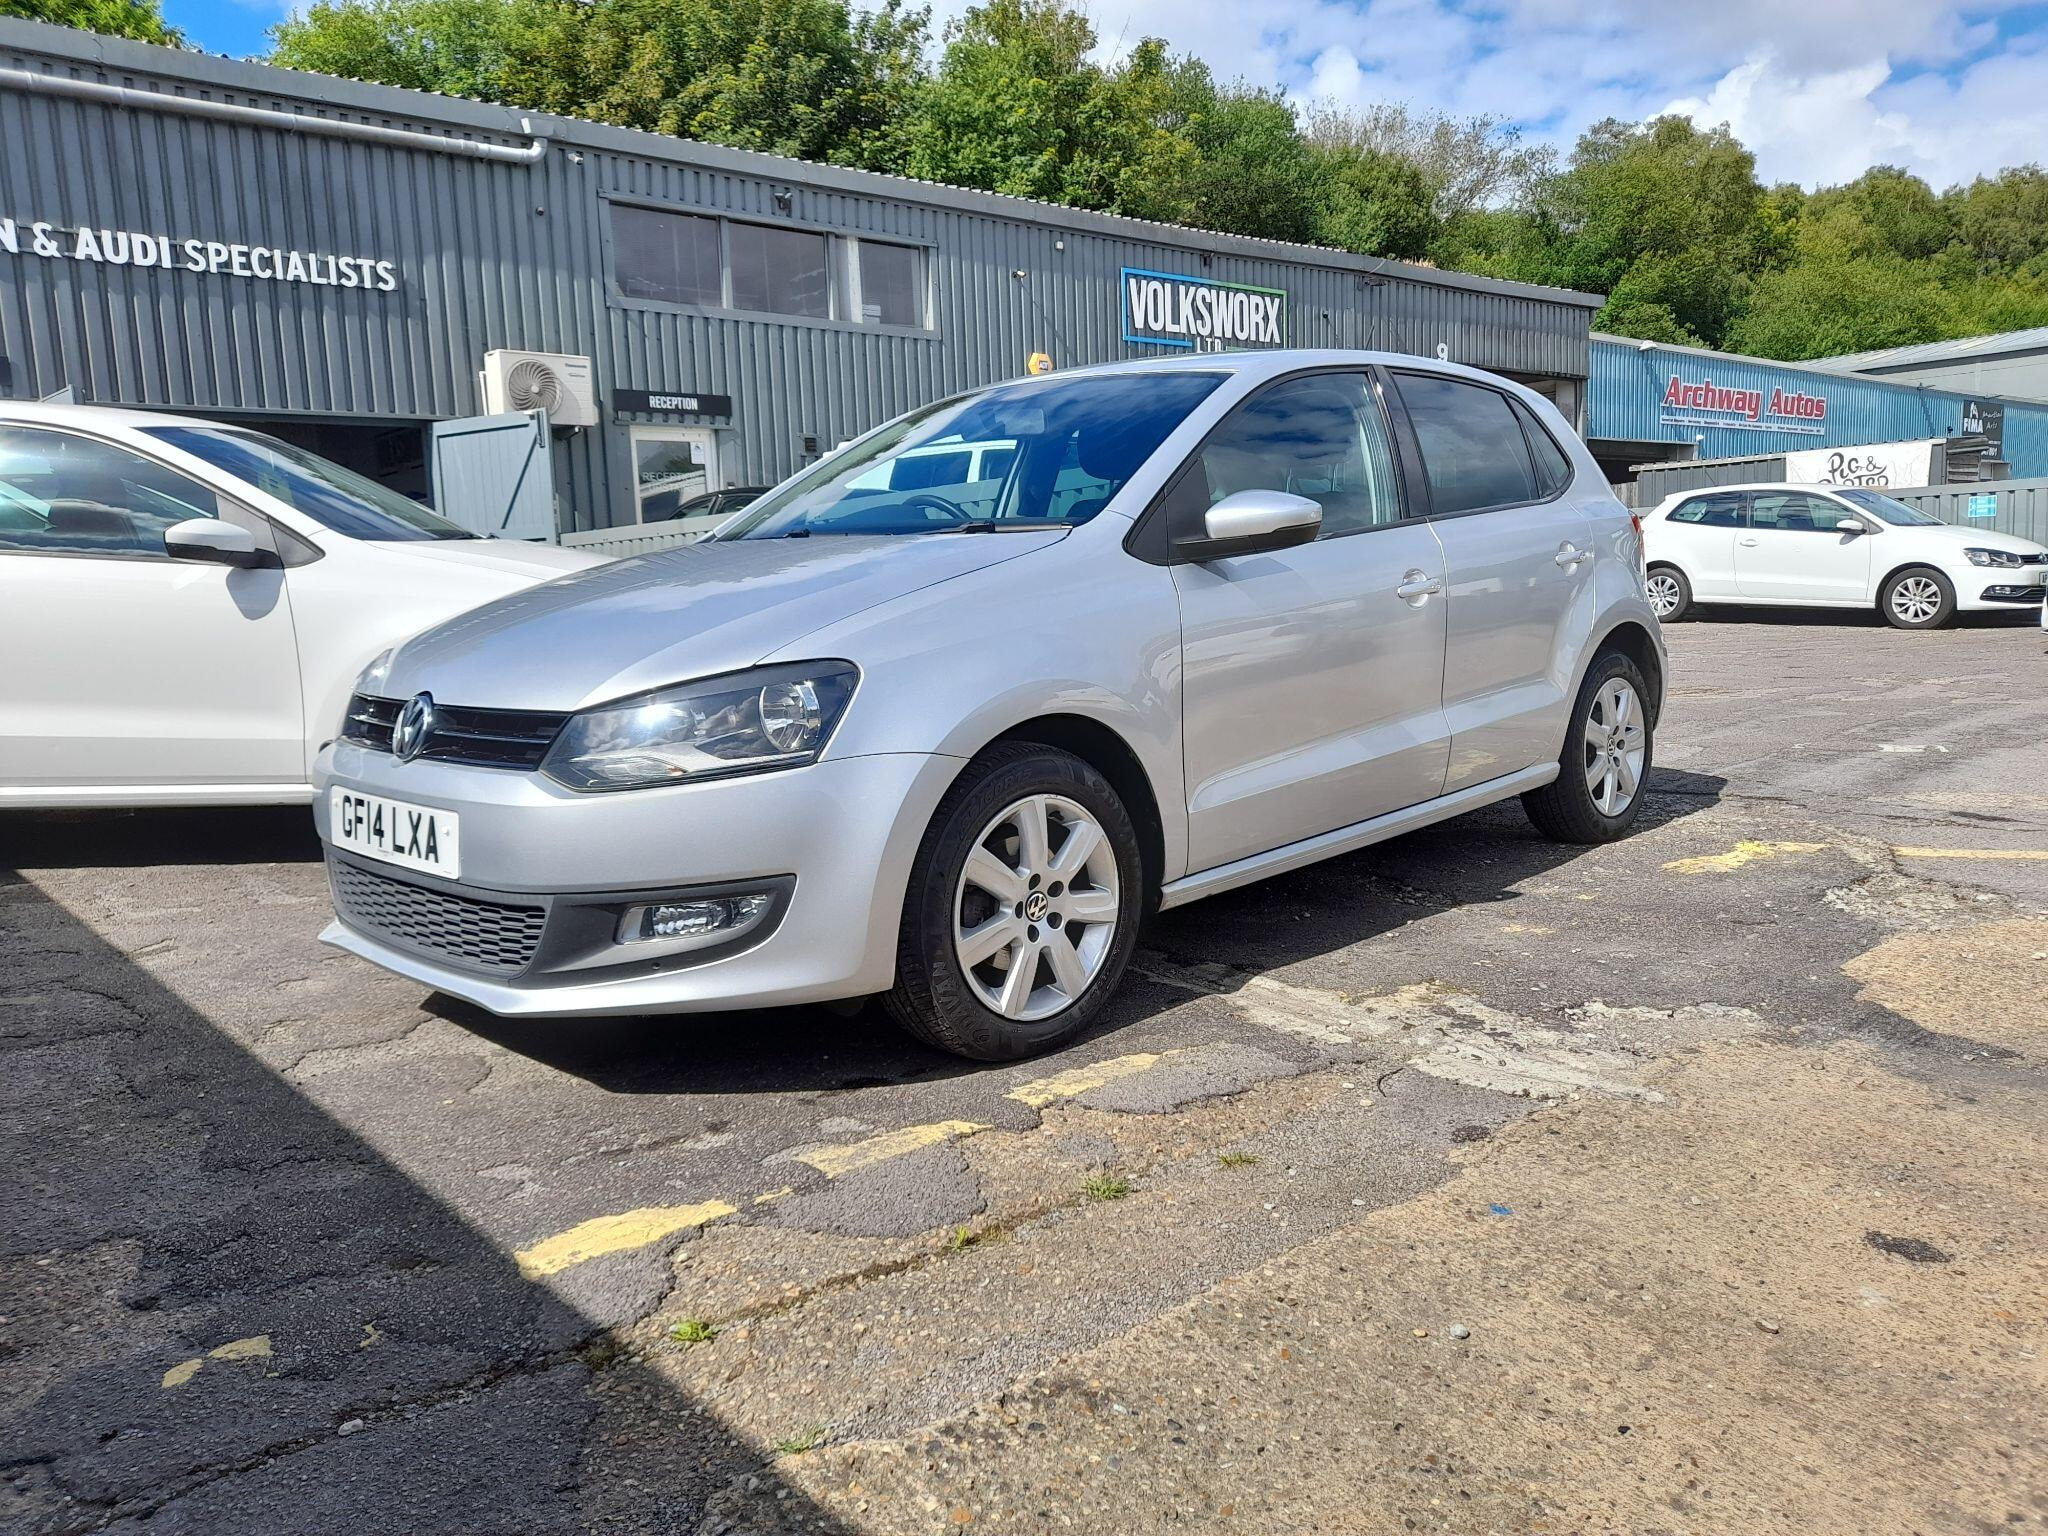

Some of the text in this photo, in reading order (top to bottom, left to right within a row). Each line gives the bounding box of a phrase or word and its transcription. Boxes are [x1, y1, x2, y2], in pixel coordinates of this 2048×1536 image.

[32, 222, 62, 258] &
[74, 226, 172, 269] AUDI
[184, 239, 396, 291] SPECIALISTS
[1129, 278, 1281, 344] VOLKSWORX
[1197, 336, 1222, 352] LTD
[1437, 342, 1448, 361] 9
[649, 395, 698, 410] RECEPTION
[1661, 374, 1826, 421] Archway Autos
[1963, 417, 1984, 433] FIMA
[1866, 455, 1882, 472] &
[342, 794, 439, 864] GF14 LXA
